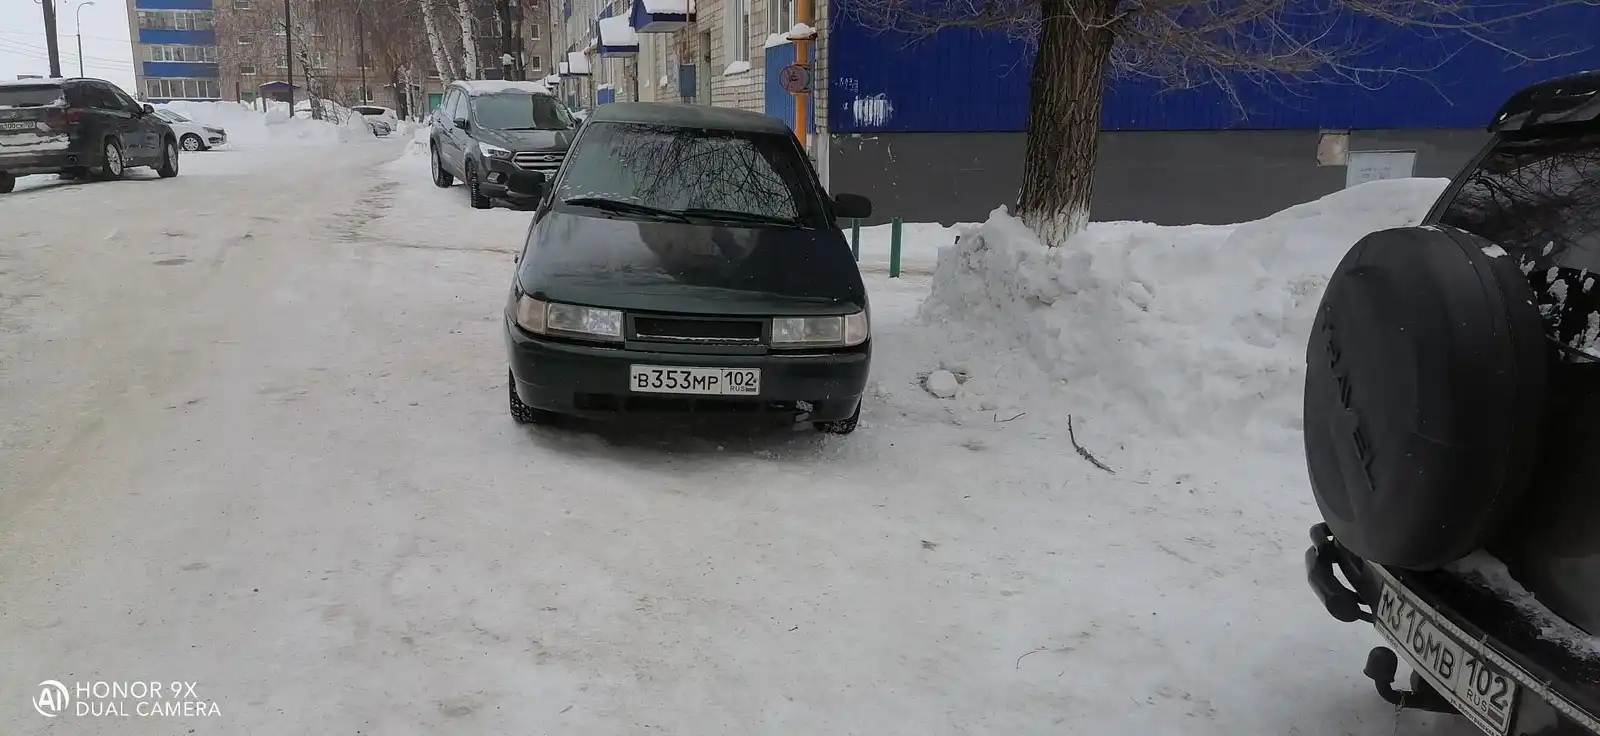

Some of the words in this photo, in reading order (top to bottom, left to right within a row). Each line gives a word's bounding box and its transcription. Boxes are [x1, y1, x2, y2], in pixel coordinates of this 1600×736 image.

[637, 370, 719, 391] В353МР
[724, 371, 755, 386] 102
[1381, 590, 1454, 680] М316МВ
[1466, 658, 1508, 711] 102
[1466, 688, 1488, 713] RUS
